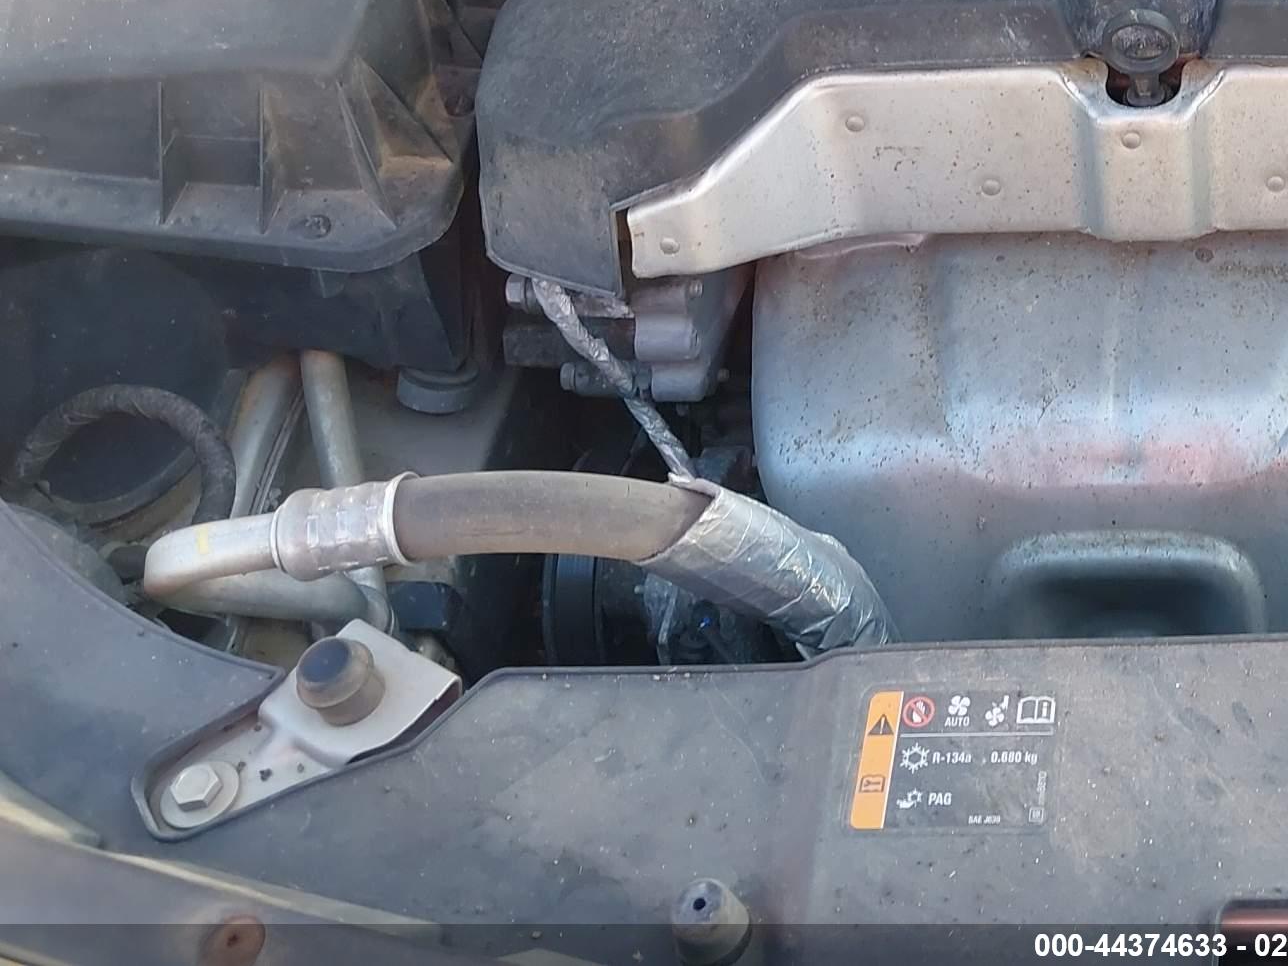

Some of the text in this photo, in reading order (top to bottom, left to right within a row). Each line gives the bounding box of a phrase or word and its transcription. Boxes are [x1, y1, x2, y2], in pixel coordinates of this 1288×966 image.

[944, 716, 970, 727] AUTO
[932, 752, 972, 764] R-134a
[1025, 751, 1038, 765] kg
[928, 793, 952, 806] PAG
